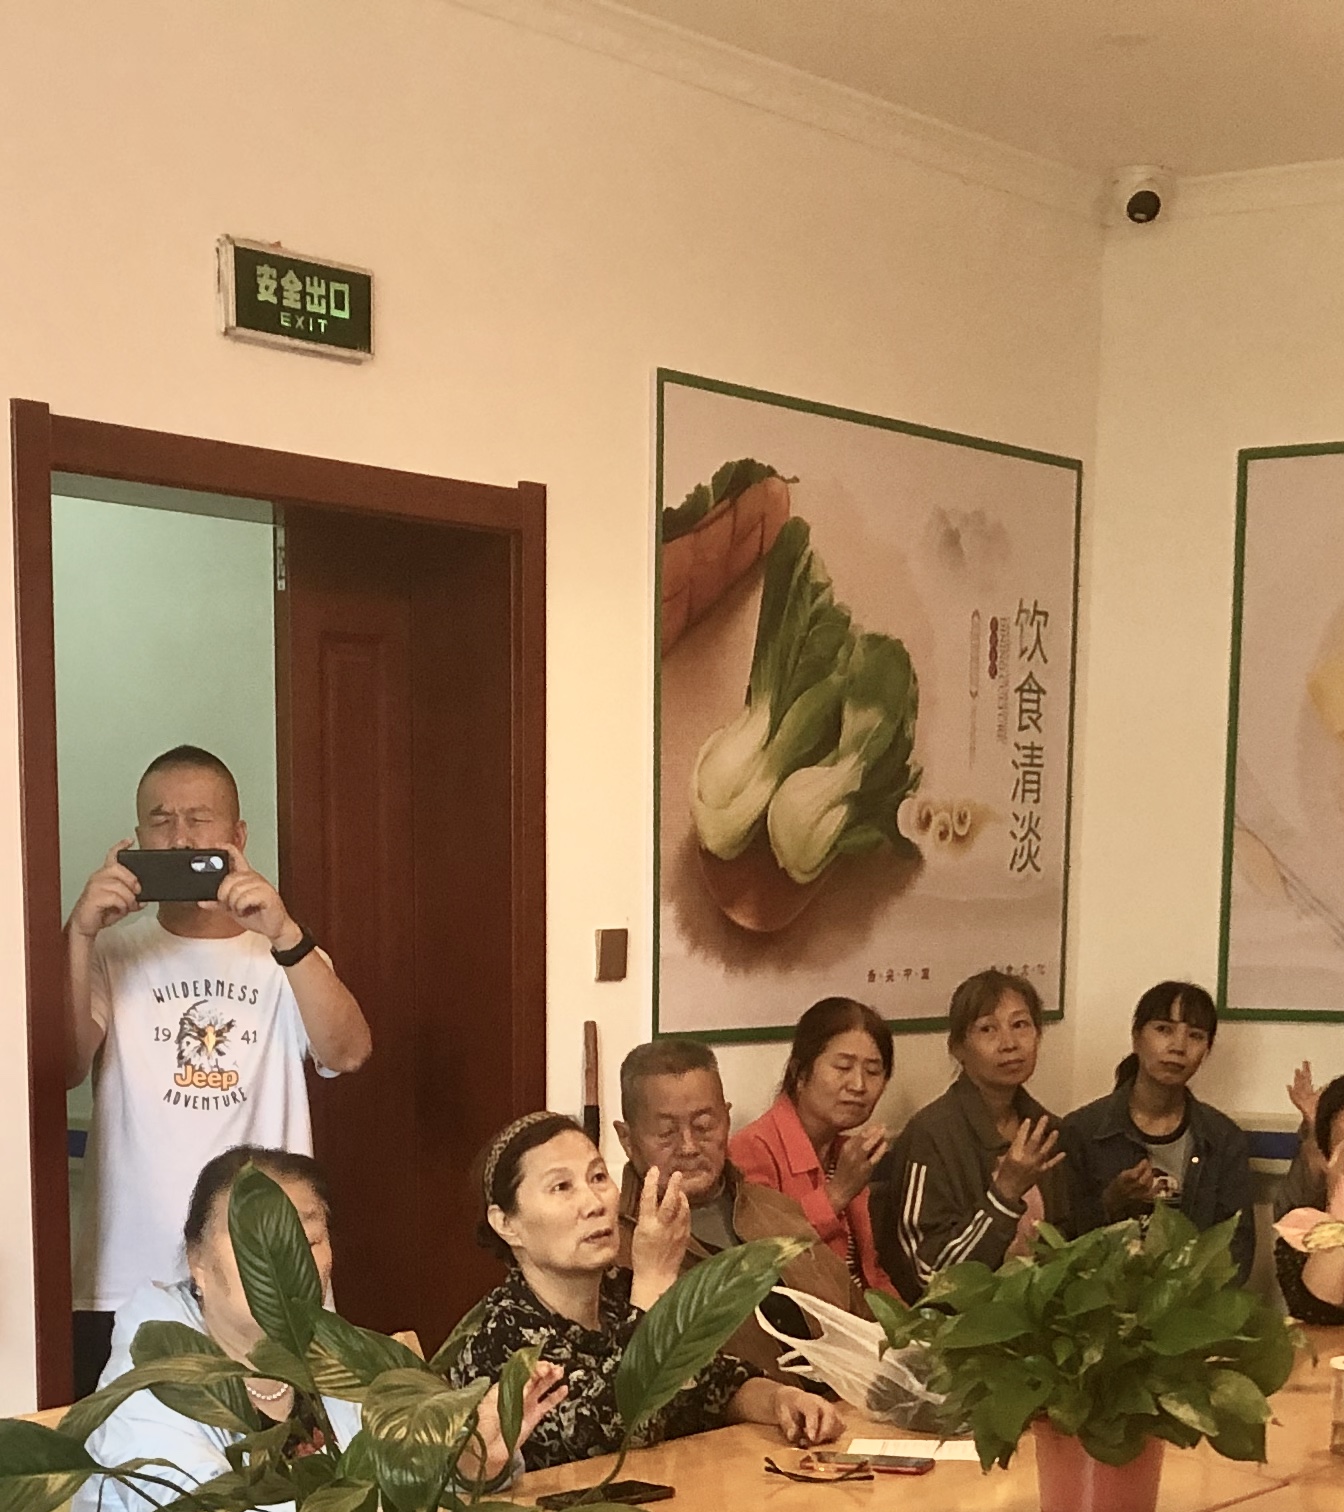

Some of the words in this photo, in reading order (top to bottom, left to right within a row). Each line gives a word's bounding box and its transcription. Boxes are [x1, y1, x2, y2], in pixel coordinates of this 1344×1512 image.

[256, 263, 350, 319] 安全出口
[280, 311, 328, 333] EXIT
[1009, 597, 1050, 873] 饮食清淡
[152, 979, 259, 1005] WILDERNESS
[153, 1026, 171, 1042] 19
[241, 1029, 258, 1043] 41
[173, 1064, 239, 1091] Jeep
[163, 1087, 247, 1110] ADVENTURE
